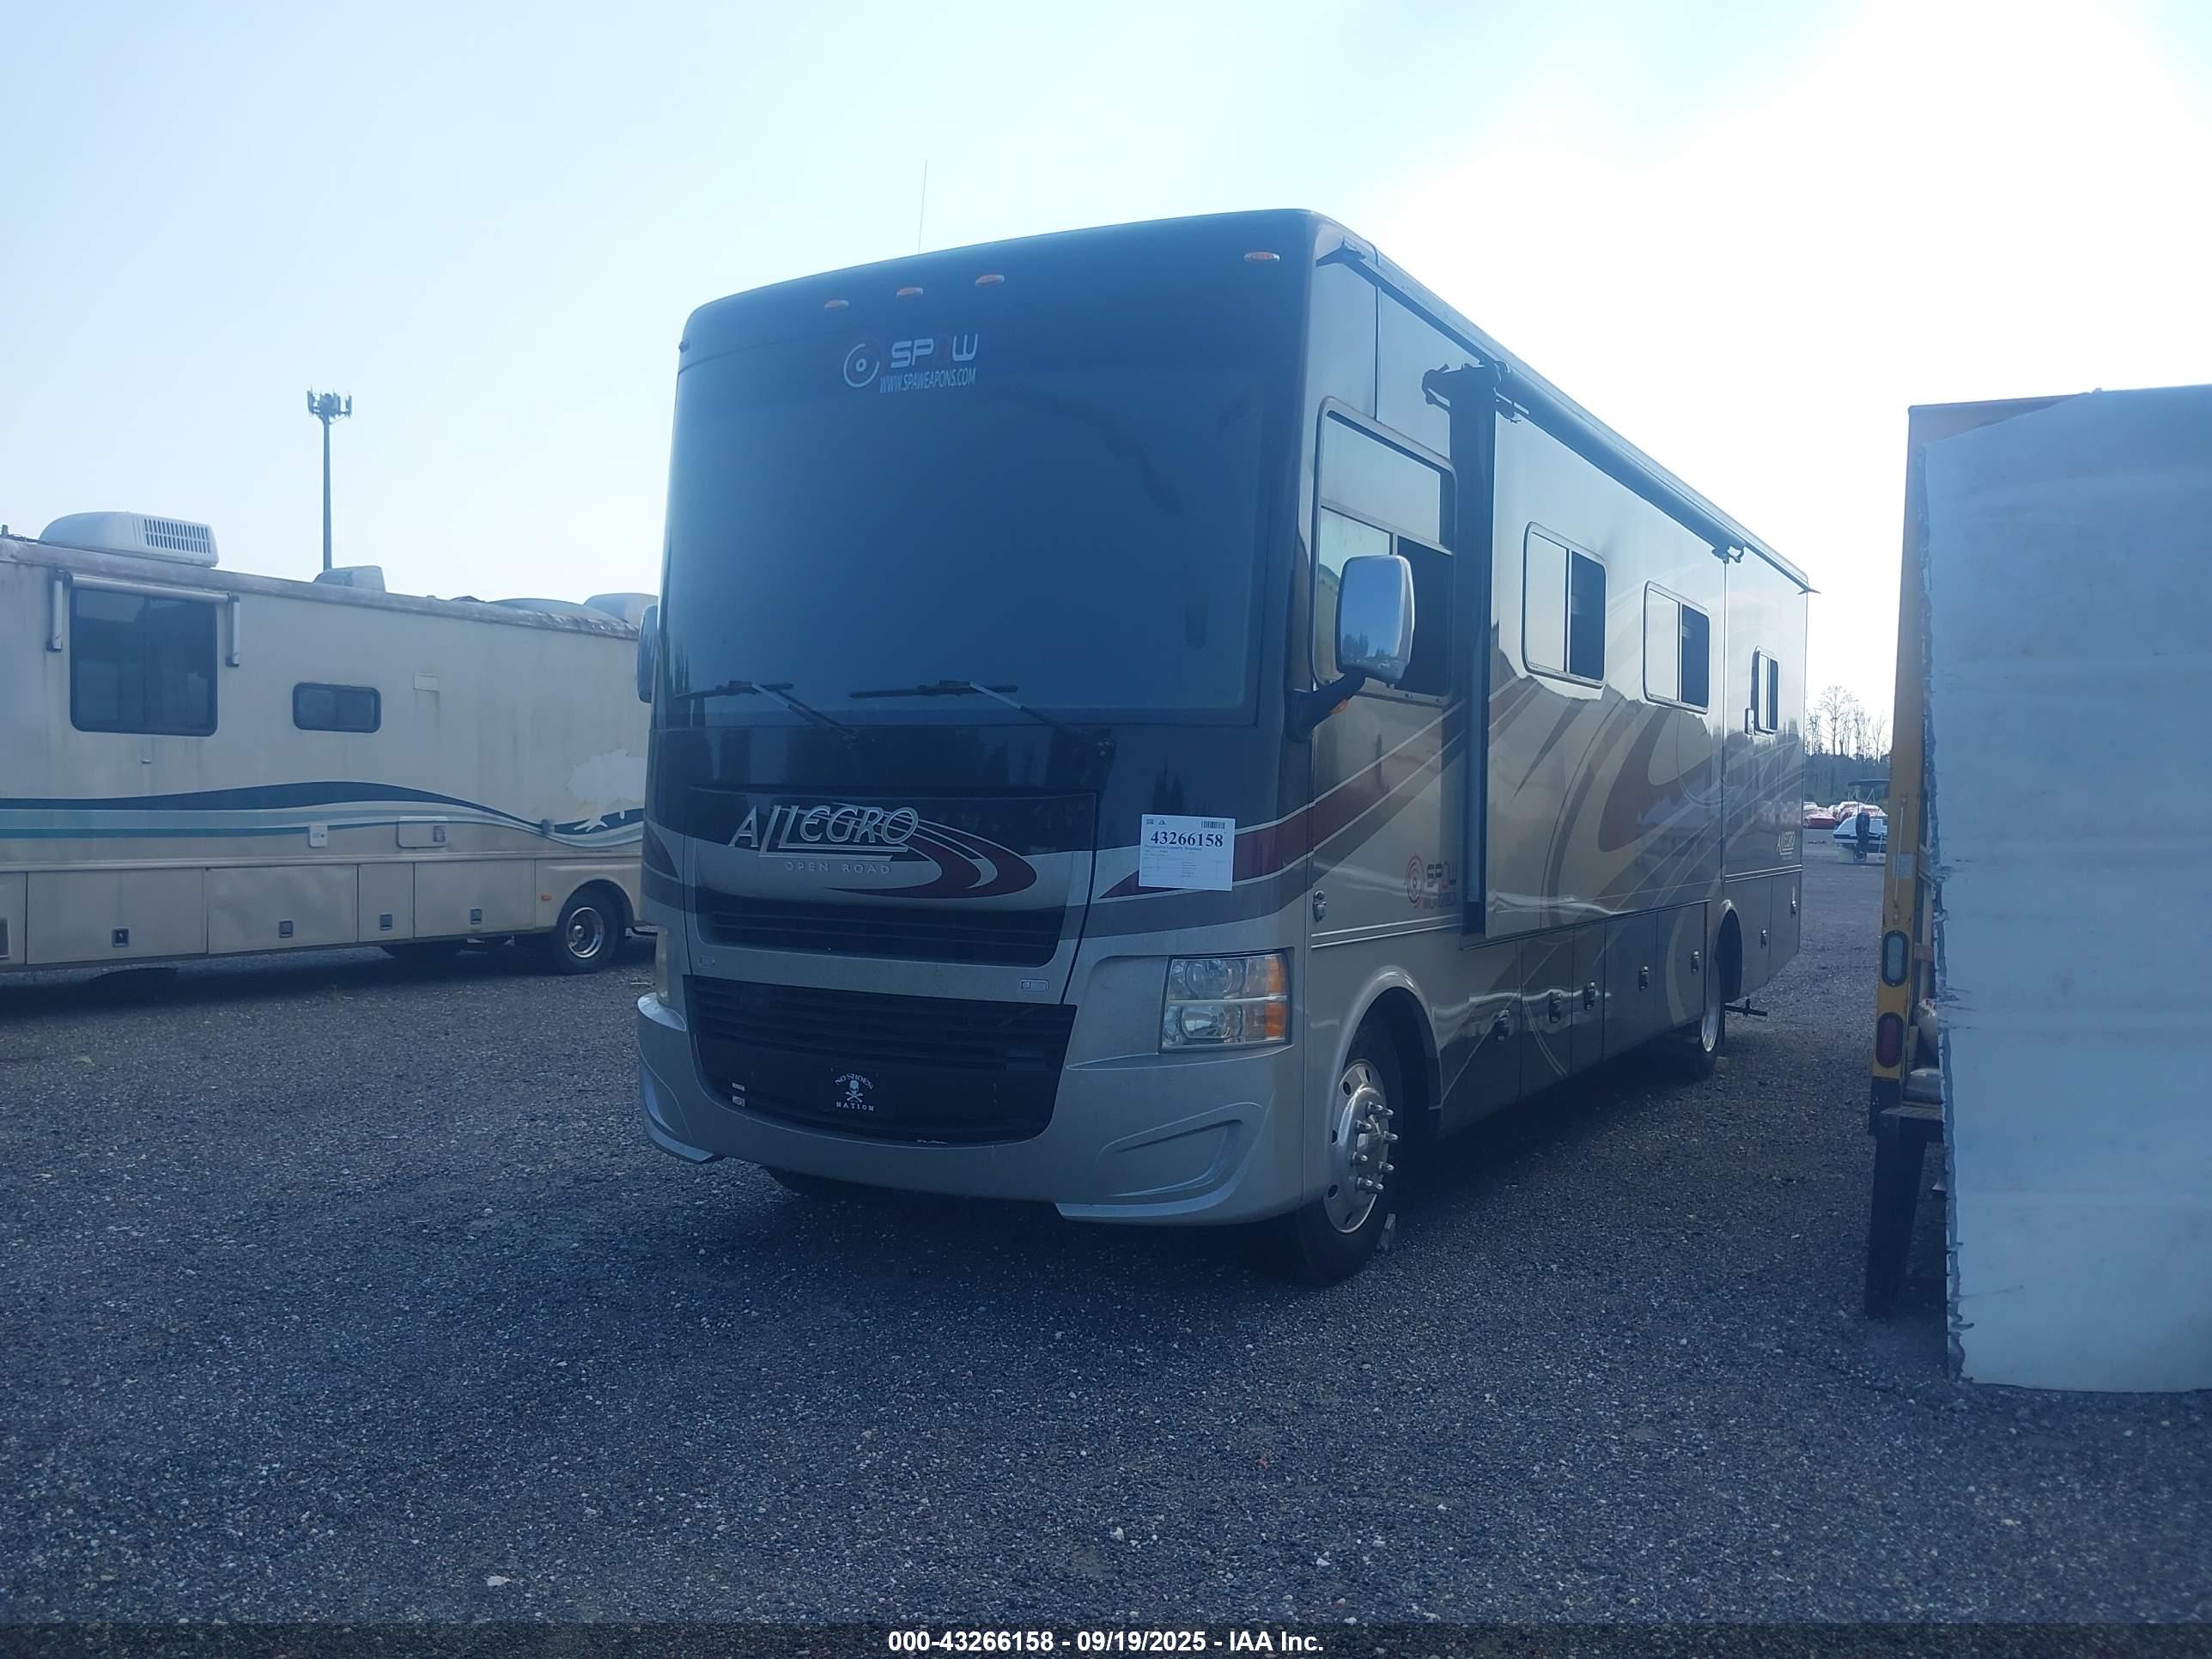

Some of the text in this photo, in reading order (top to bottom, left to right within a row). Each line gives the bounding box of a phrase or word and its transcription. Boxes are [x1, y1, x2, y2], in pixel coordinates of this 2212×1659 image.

[879, 368, 976, 393] WWW.SPAWEAPONS.COM
[728, 805, 919, 861] ALLEGRO
[1151, 830, 1224, 848] 43266158
[785, 860, 892, 875] OPEN ROAD
[836, 1102, 874, 1113] NATION
